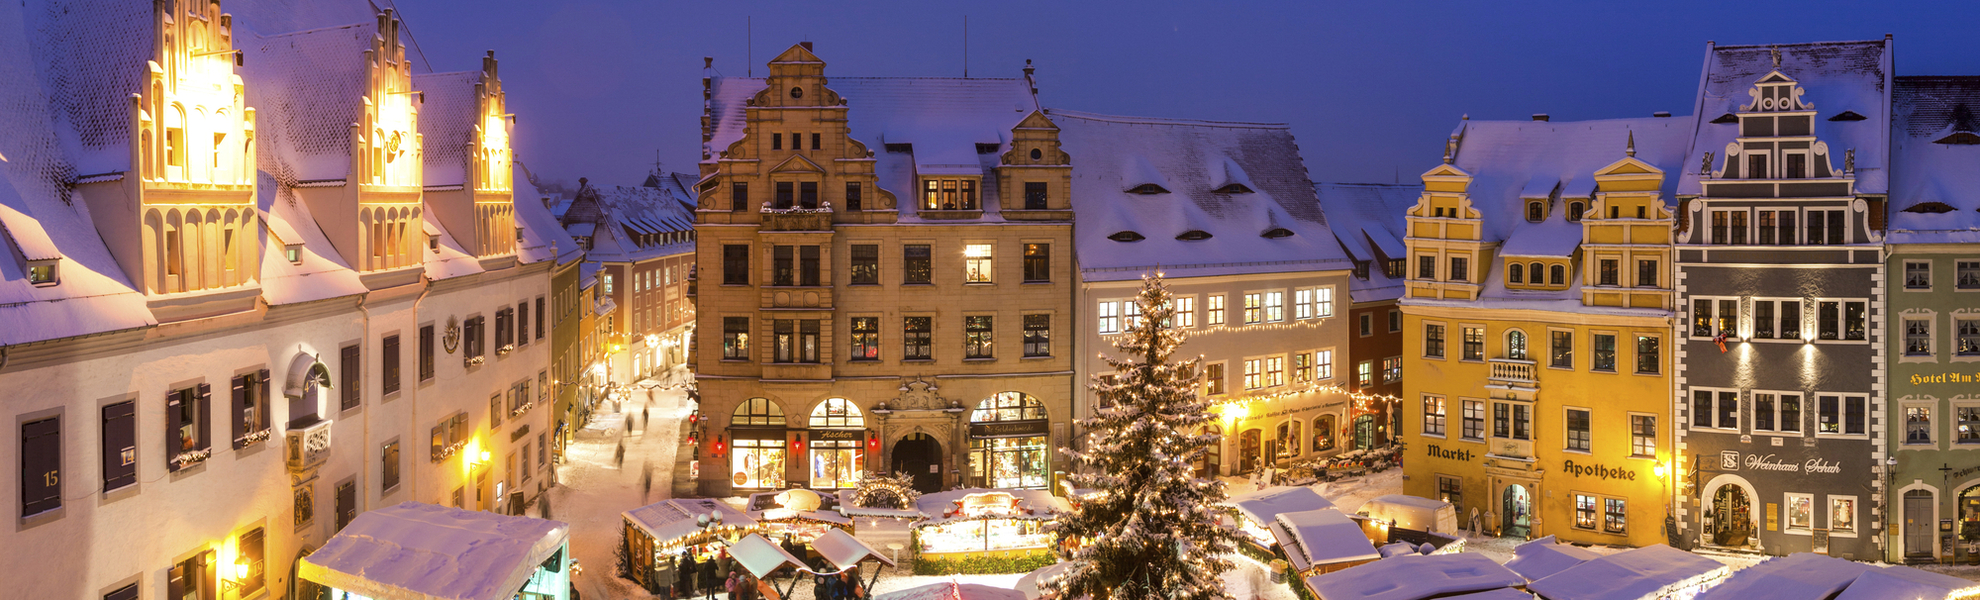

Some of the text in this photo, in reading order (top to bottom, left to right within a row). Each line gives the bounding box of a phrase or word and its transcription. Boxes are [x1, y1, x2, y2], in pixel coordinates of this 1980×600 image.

[352, 380, 359, 391] 12
[1910, 373, 1947, 387] Hotel
[1949, 372, 1972, 383] Am
[121, 449, 134, 465] 14
[1427, 444, 1475, 462] Markt-
[1563, 460, 1636, 481] Apotheke
[1744, 454, 1842, 475] Weinhaus Schuh
[43, 470, 58, 487] 15
